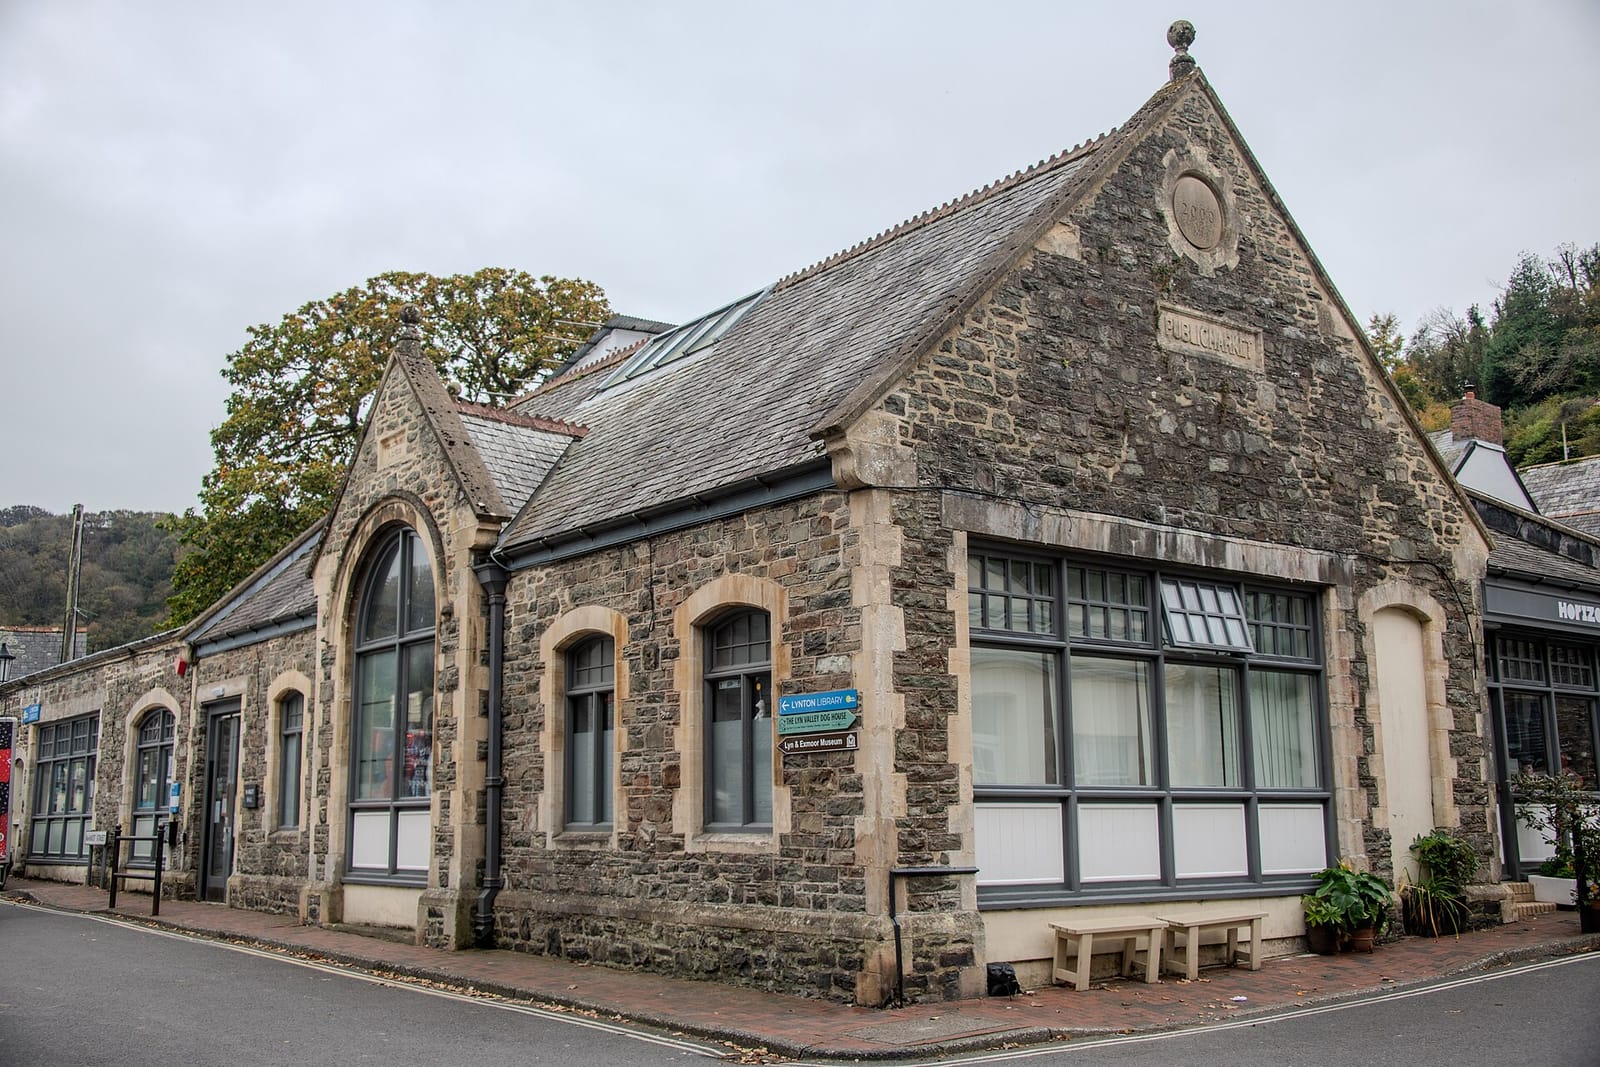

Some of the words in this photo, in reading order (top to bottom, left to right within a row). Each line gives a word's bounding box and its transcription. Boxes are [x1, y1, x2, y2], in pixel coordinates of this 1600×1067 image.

[1163, 314, 1208, 348] PUBLIC
[791, 699, 816, 709] LYNTON
[817, 696, 843, 707] LIBRARY
[786, 717, 794, 725] THE
[795, 716, 803, 724] LYN
[804, 714, 820, 723] VALLEY
[820, 713, 831, 722] DOG
[831, 712, 847, 720] HOUSE
[784, 741, 794, 750] Lyn
[800, 740, 820, 748] Exmoor
[820, 738, 842, 746] Museum
